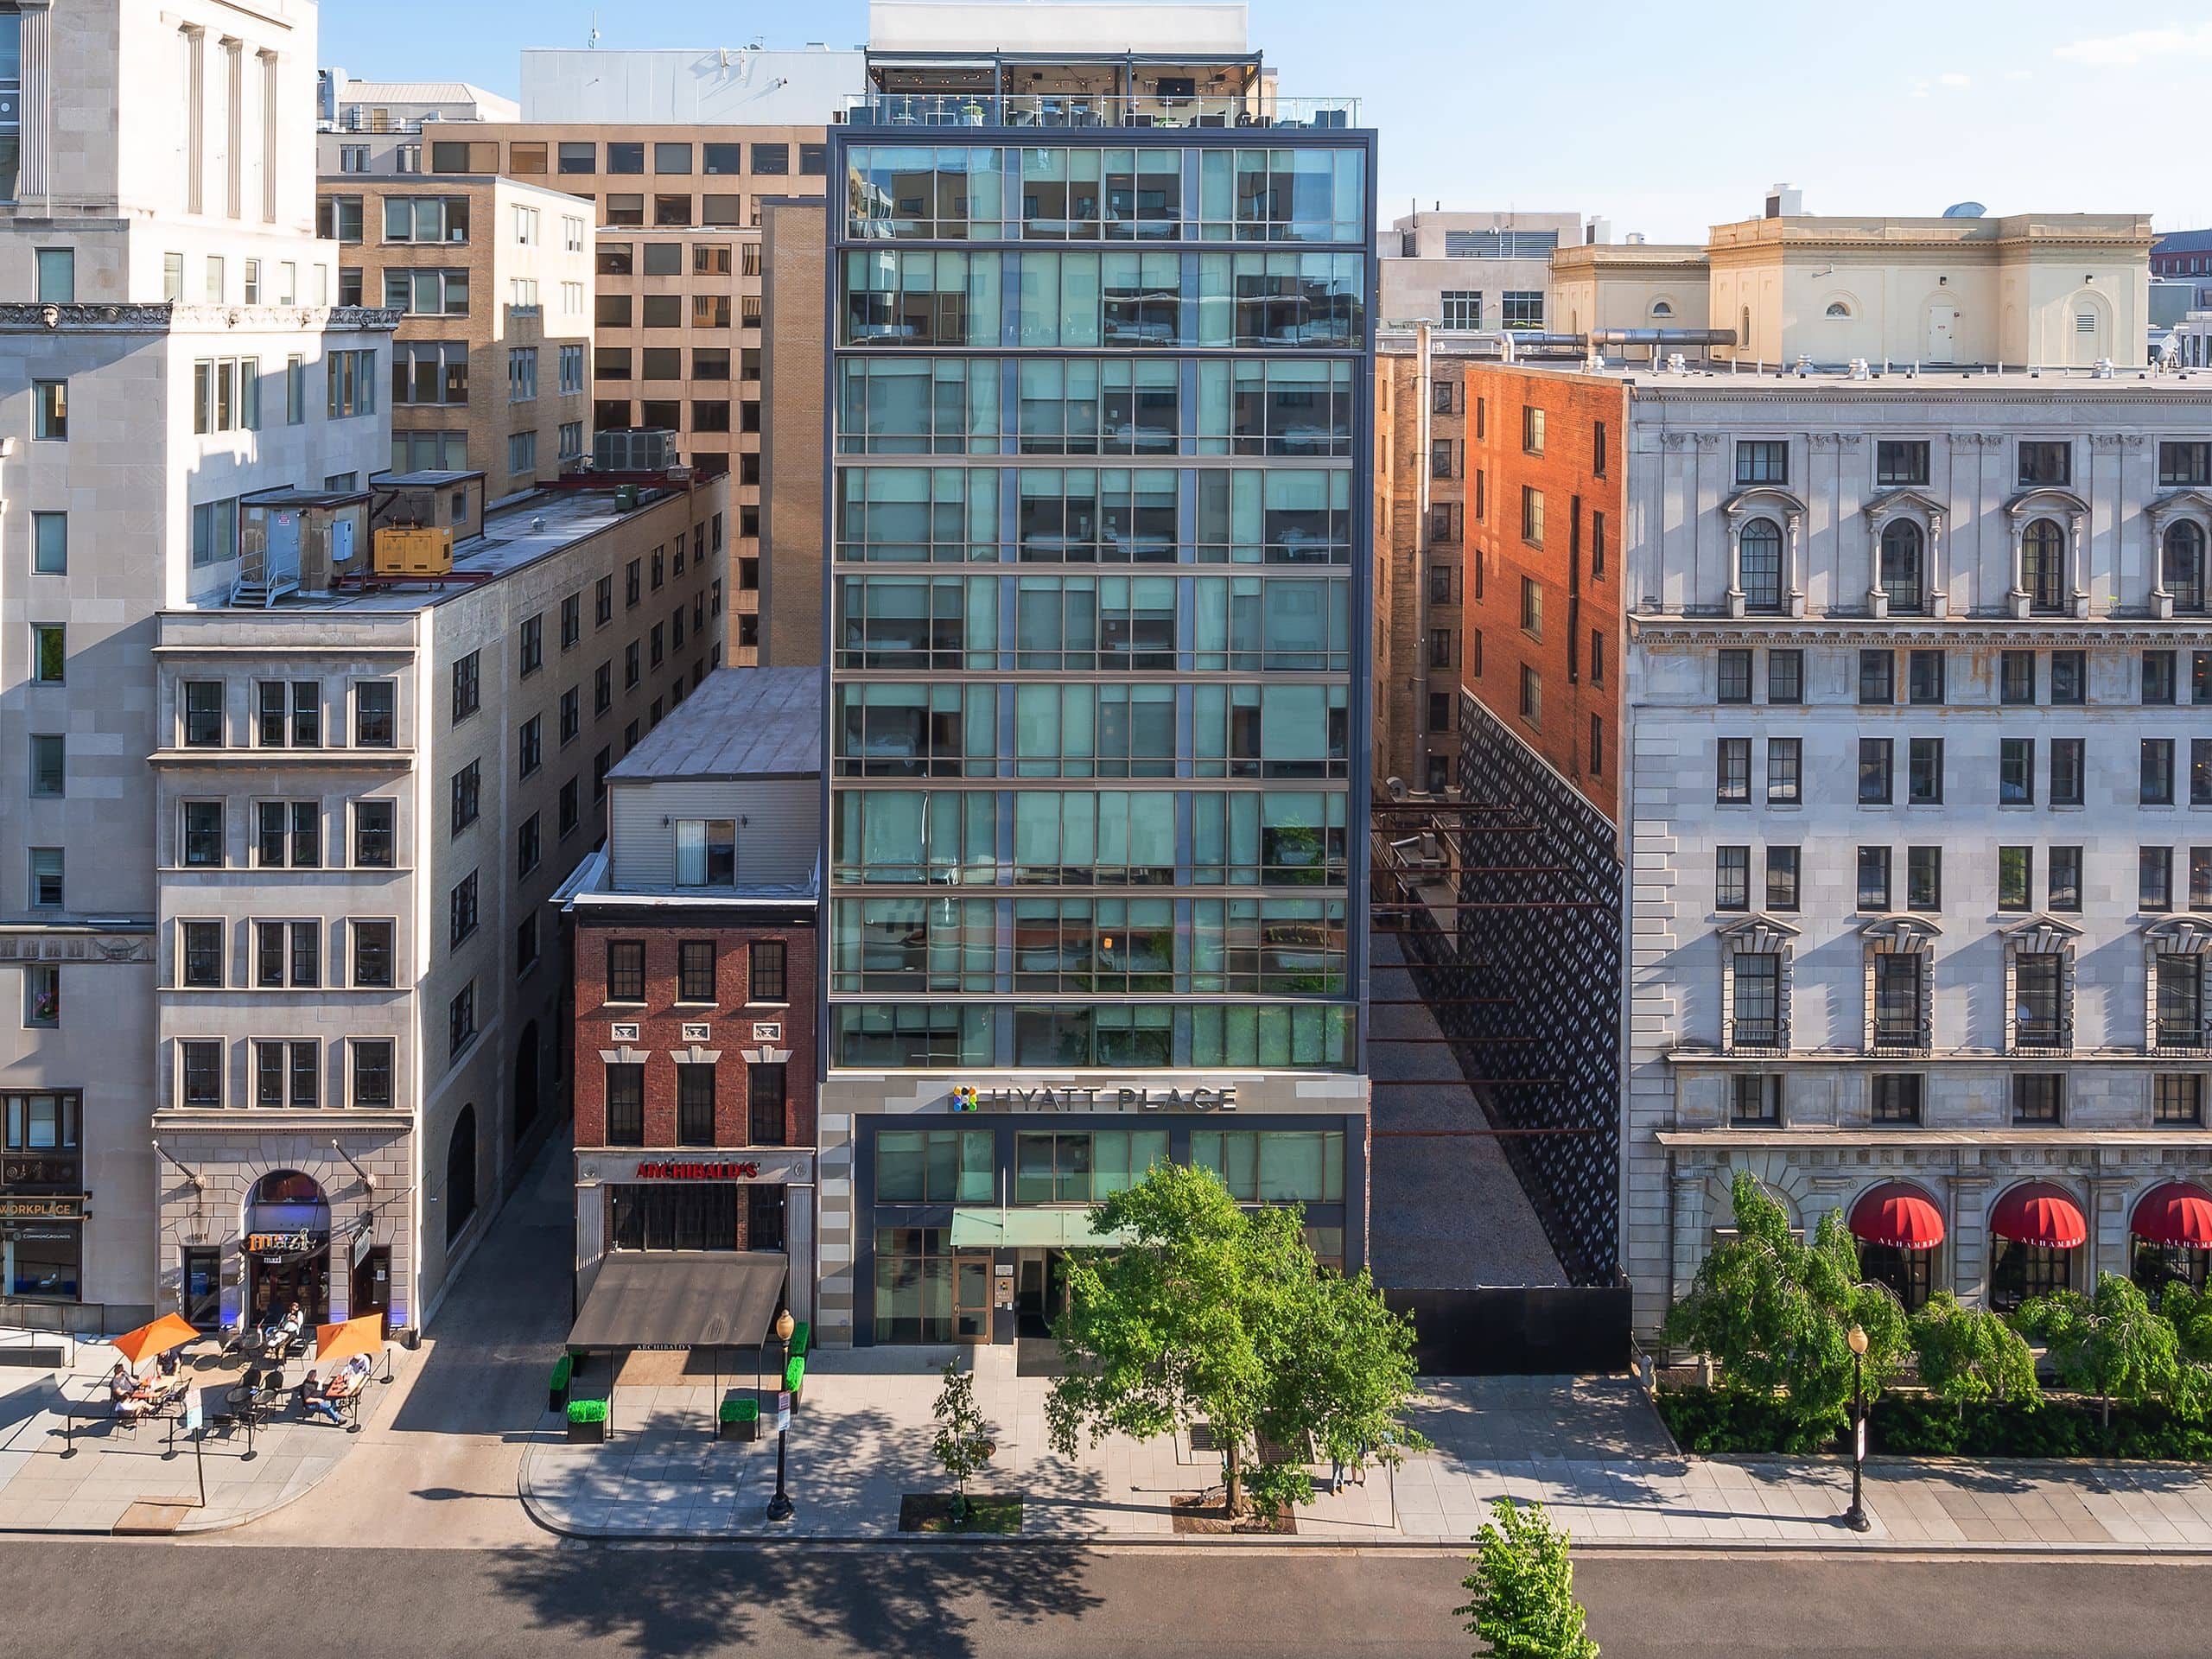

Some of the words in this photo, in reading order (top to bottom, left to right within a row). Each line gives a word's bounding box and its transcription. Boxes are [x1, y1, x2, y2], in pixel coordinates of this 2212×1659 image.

[992, 1086, 1101, 1112] HYATT
[1118, 1086, 1236, 1112] PLACE
[636, 1161, 758, 1179] ARCHIBALD'S
[0, 1205, 71, 1215] WORKPLACE
[2021, 1236, 2082, 1248] ALHAMBRA
